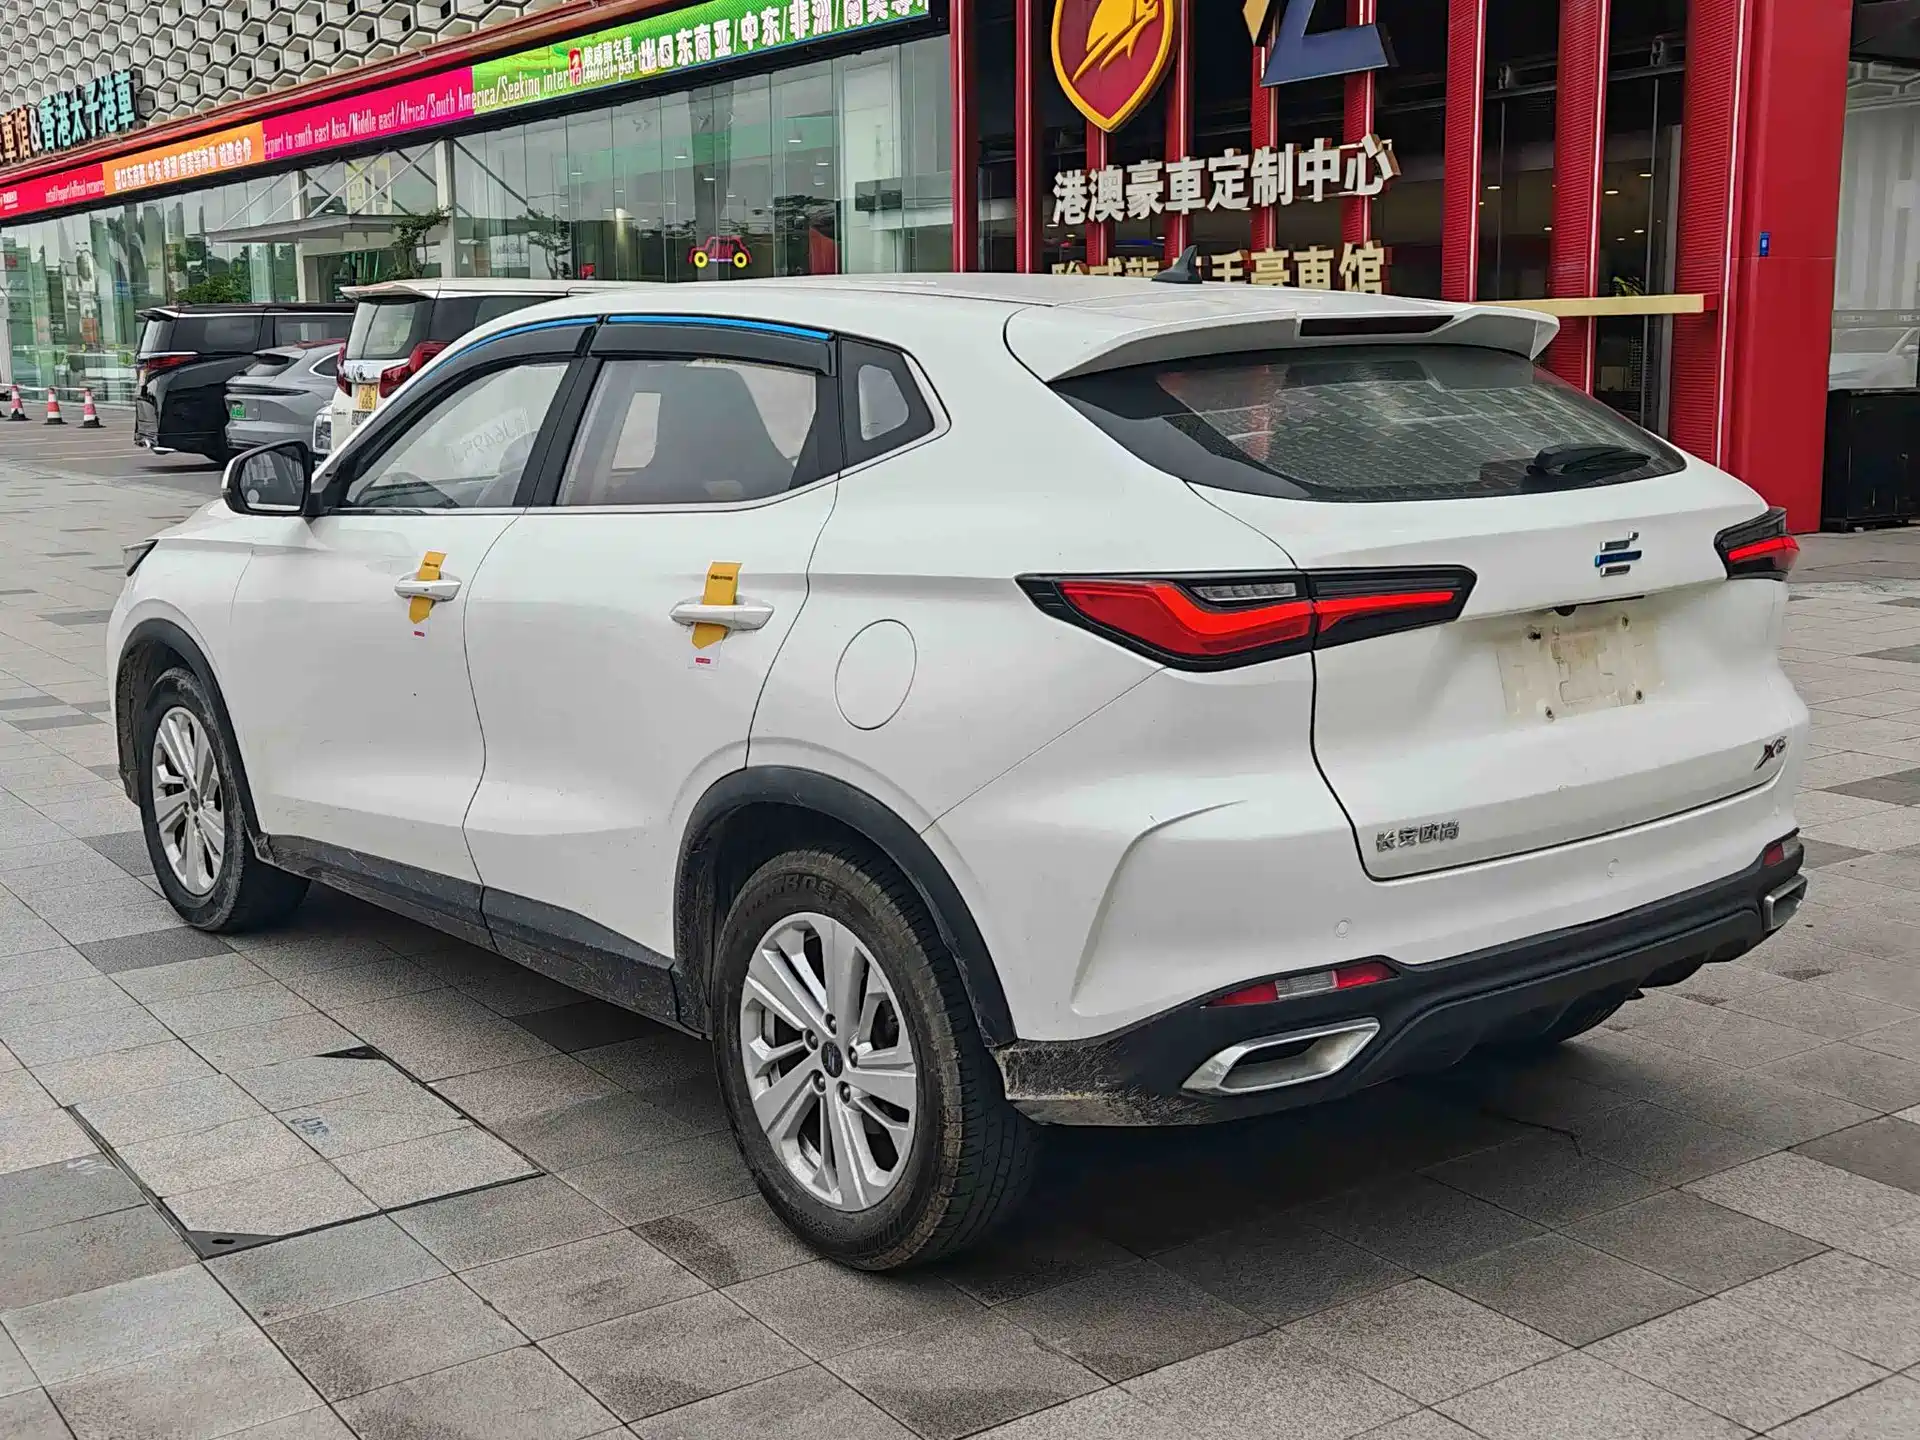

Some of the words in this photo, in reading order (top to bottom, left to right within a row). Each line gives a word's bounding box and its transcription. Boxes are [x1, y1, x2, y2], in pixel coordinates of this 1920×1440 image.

[263, 133, 284, 158] Export
[285, 130, 293, 150] to
[294, 121, 313, 149] south
[314, 121, 330, 144] east
[458, 70, 540, 113] America/Seeking
[1053, 134, 1401, 226] 港澳豪車定制中心
[1375, 818, 1460, 853] 长安欧尚
